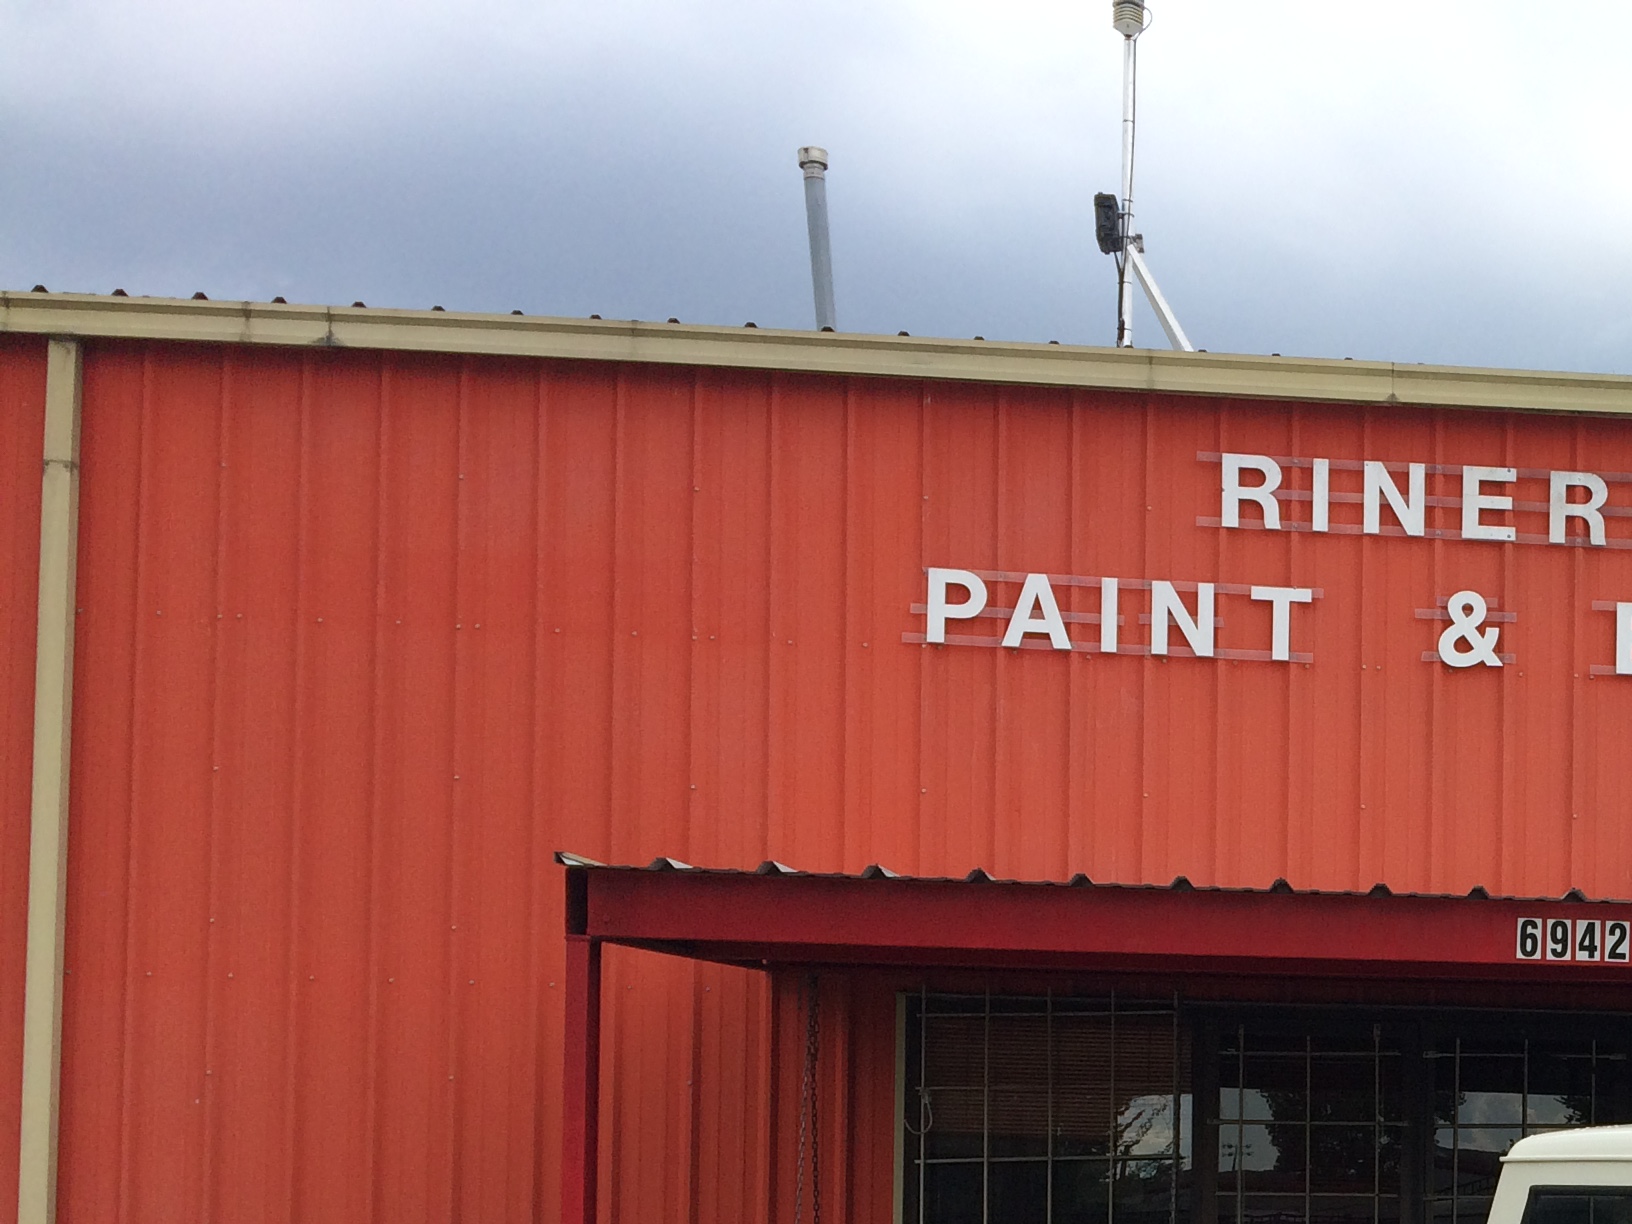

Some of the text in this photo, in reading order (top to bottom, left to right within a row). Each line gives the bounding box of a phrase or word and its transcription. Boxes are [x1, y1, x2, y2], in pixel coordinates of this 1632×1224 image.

[926, 567, 1313, 661] PAINT
[1438, 590, 1504, 668] &
[1519, 919, 1628, 960] 6942
